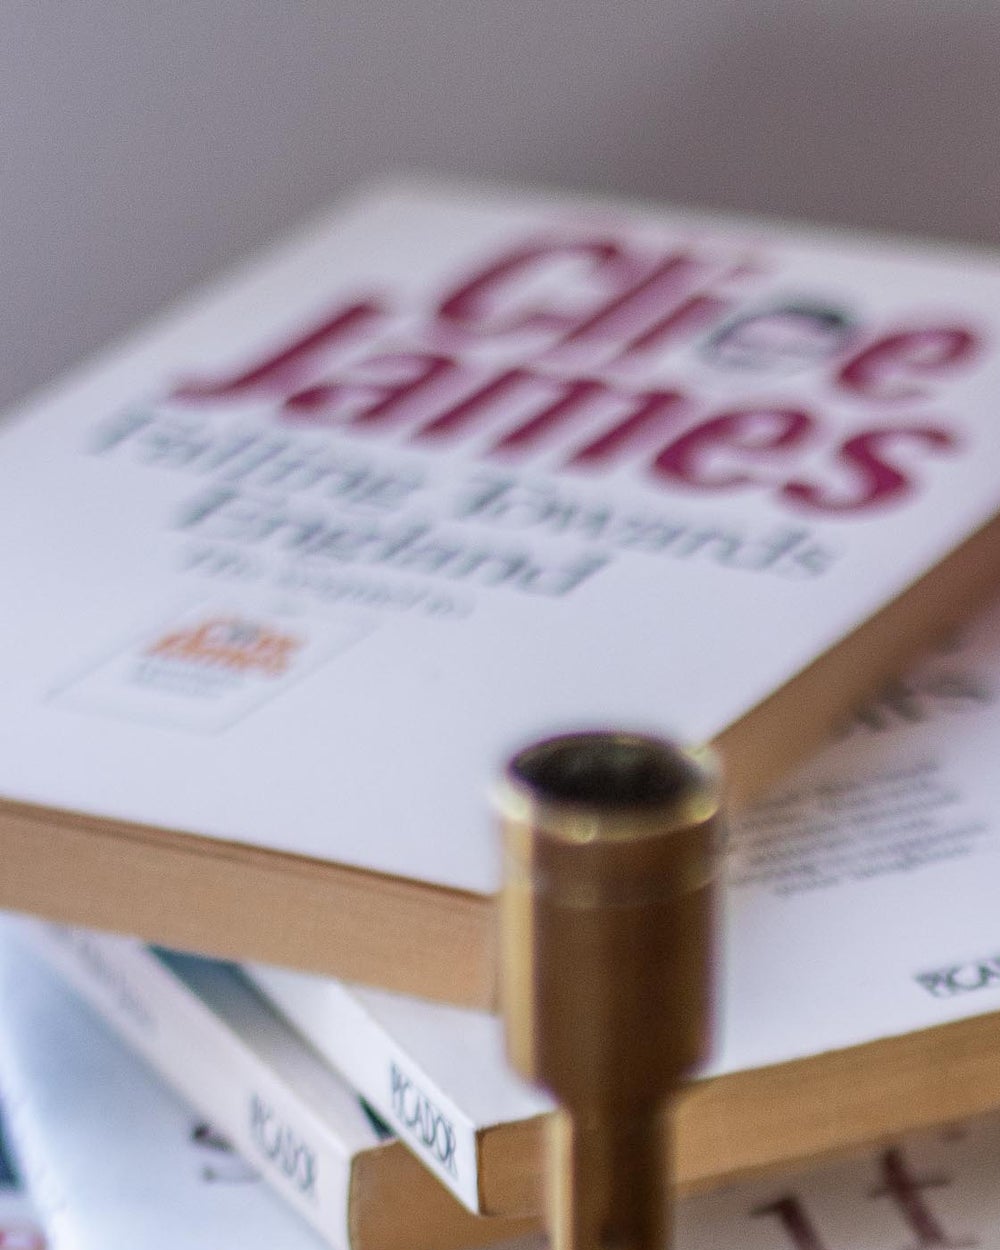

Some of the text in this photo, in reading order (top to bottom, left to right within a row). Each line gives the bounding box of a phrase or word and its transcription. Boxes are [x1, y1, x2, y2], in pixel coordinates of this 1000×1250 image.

[432, 232, 982, 398] Clie
[172, 297, 962, 516] James
[176, 486, 612, 600] England
[247, 1090, 319, 1200] PICADOR
[388, 1060, 460, 1182] PICADOR
